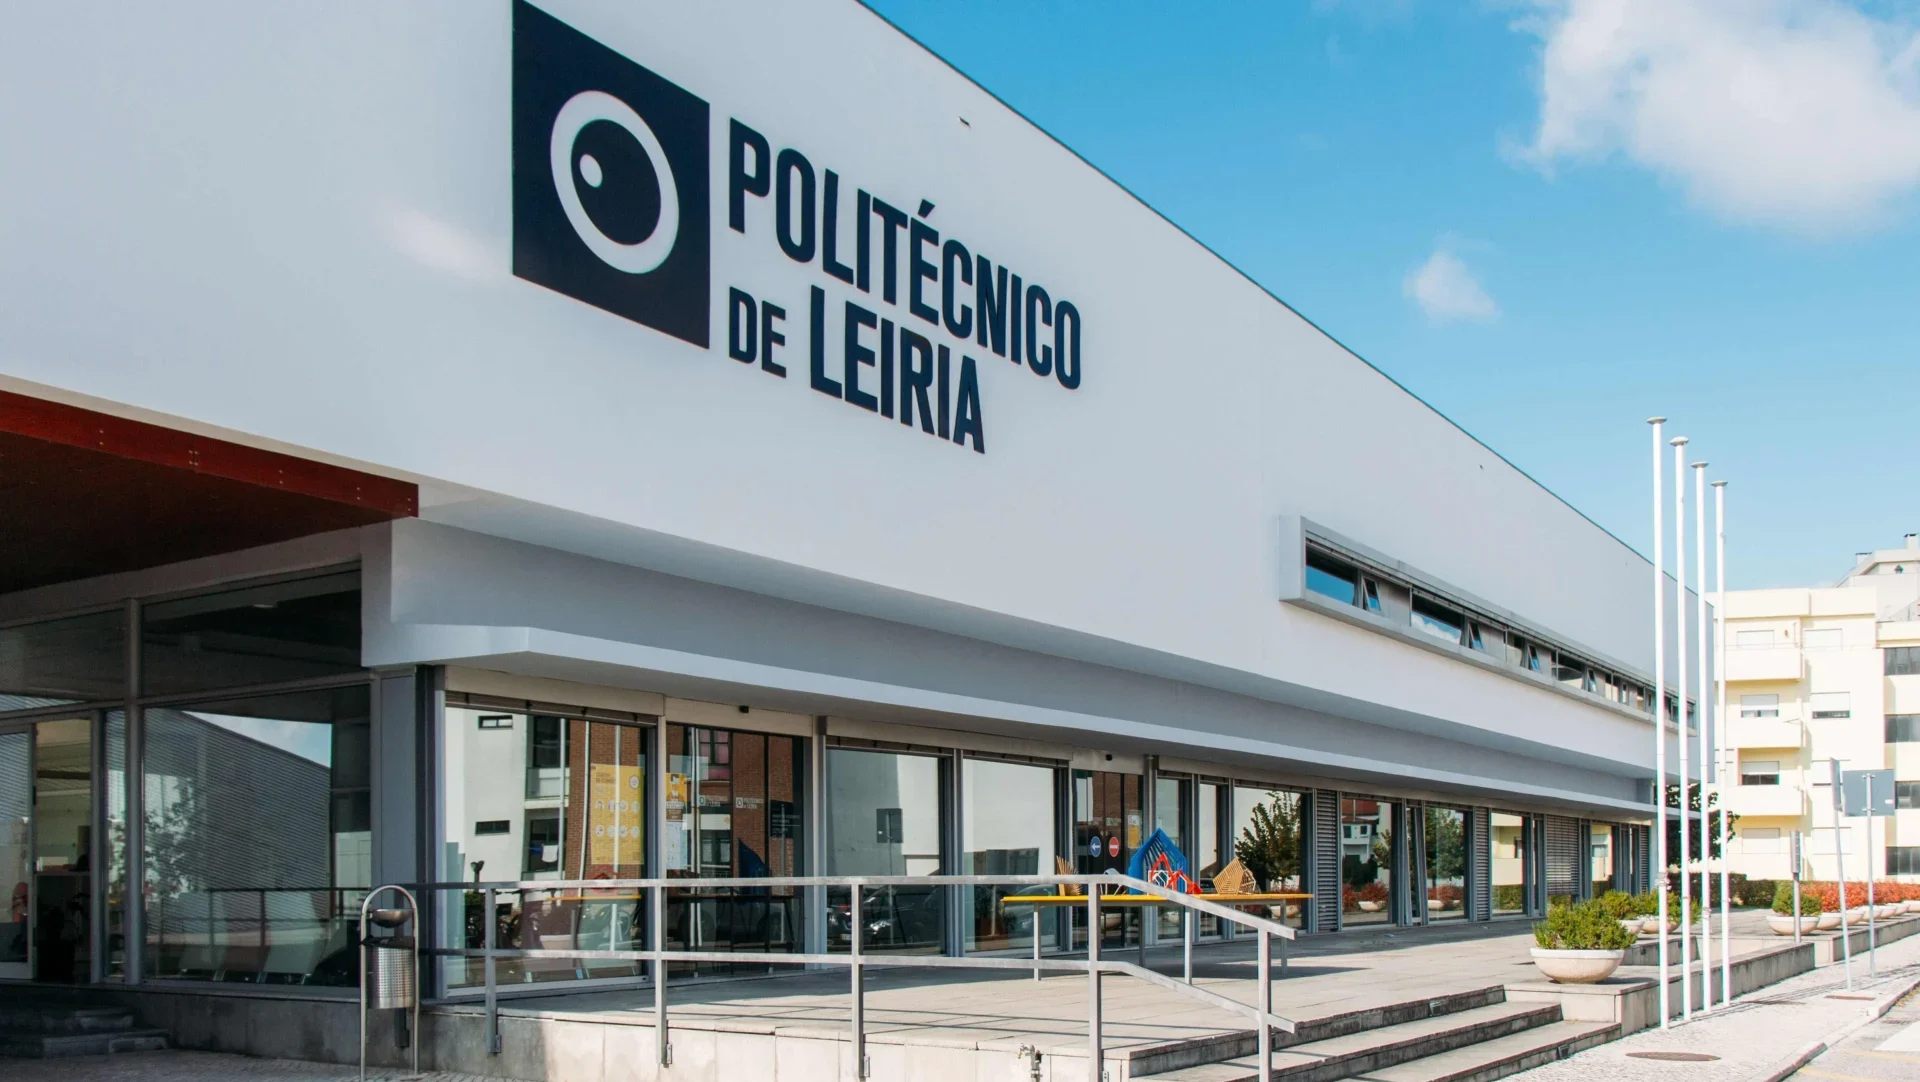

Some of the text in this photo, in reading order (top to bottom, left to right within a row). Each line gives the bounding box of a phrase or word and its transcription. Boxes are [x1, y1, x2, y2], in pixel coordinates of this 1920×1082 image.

[729, 117, 1081, 390] POLITÉCNICO
[729, 284, 985, 455] DE LEIRIA
